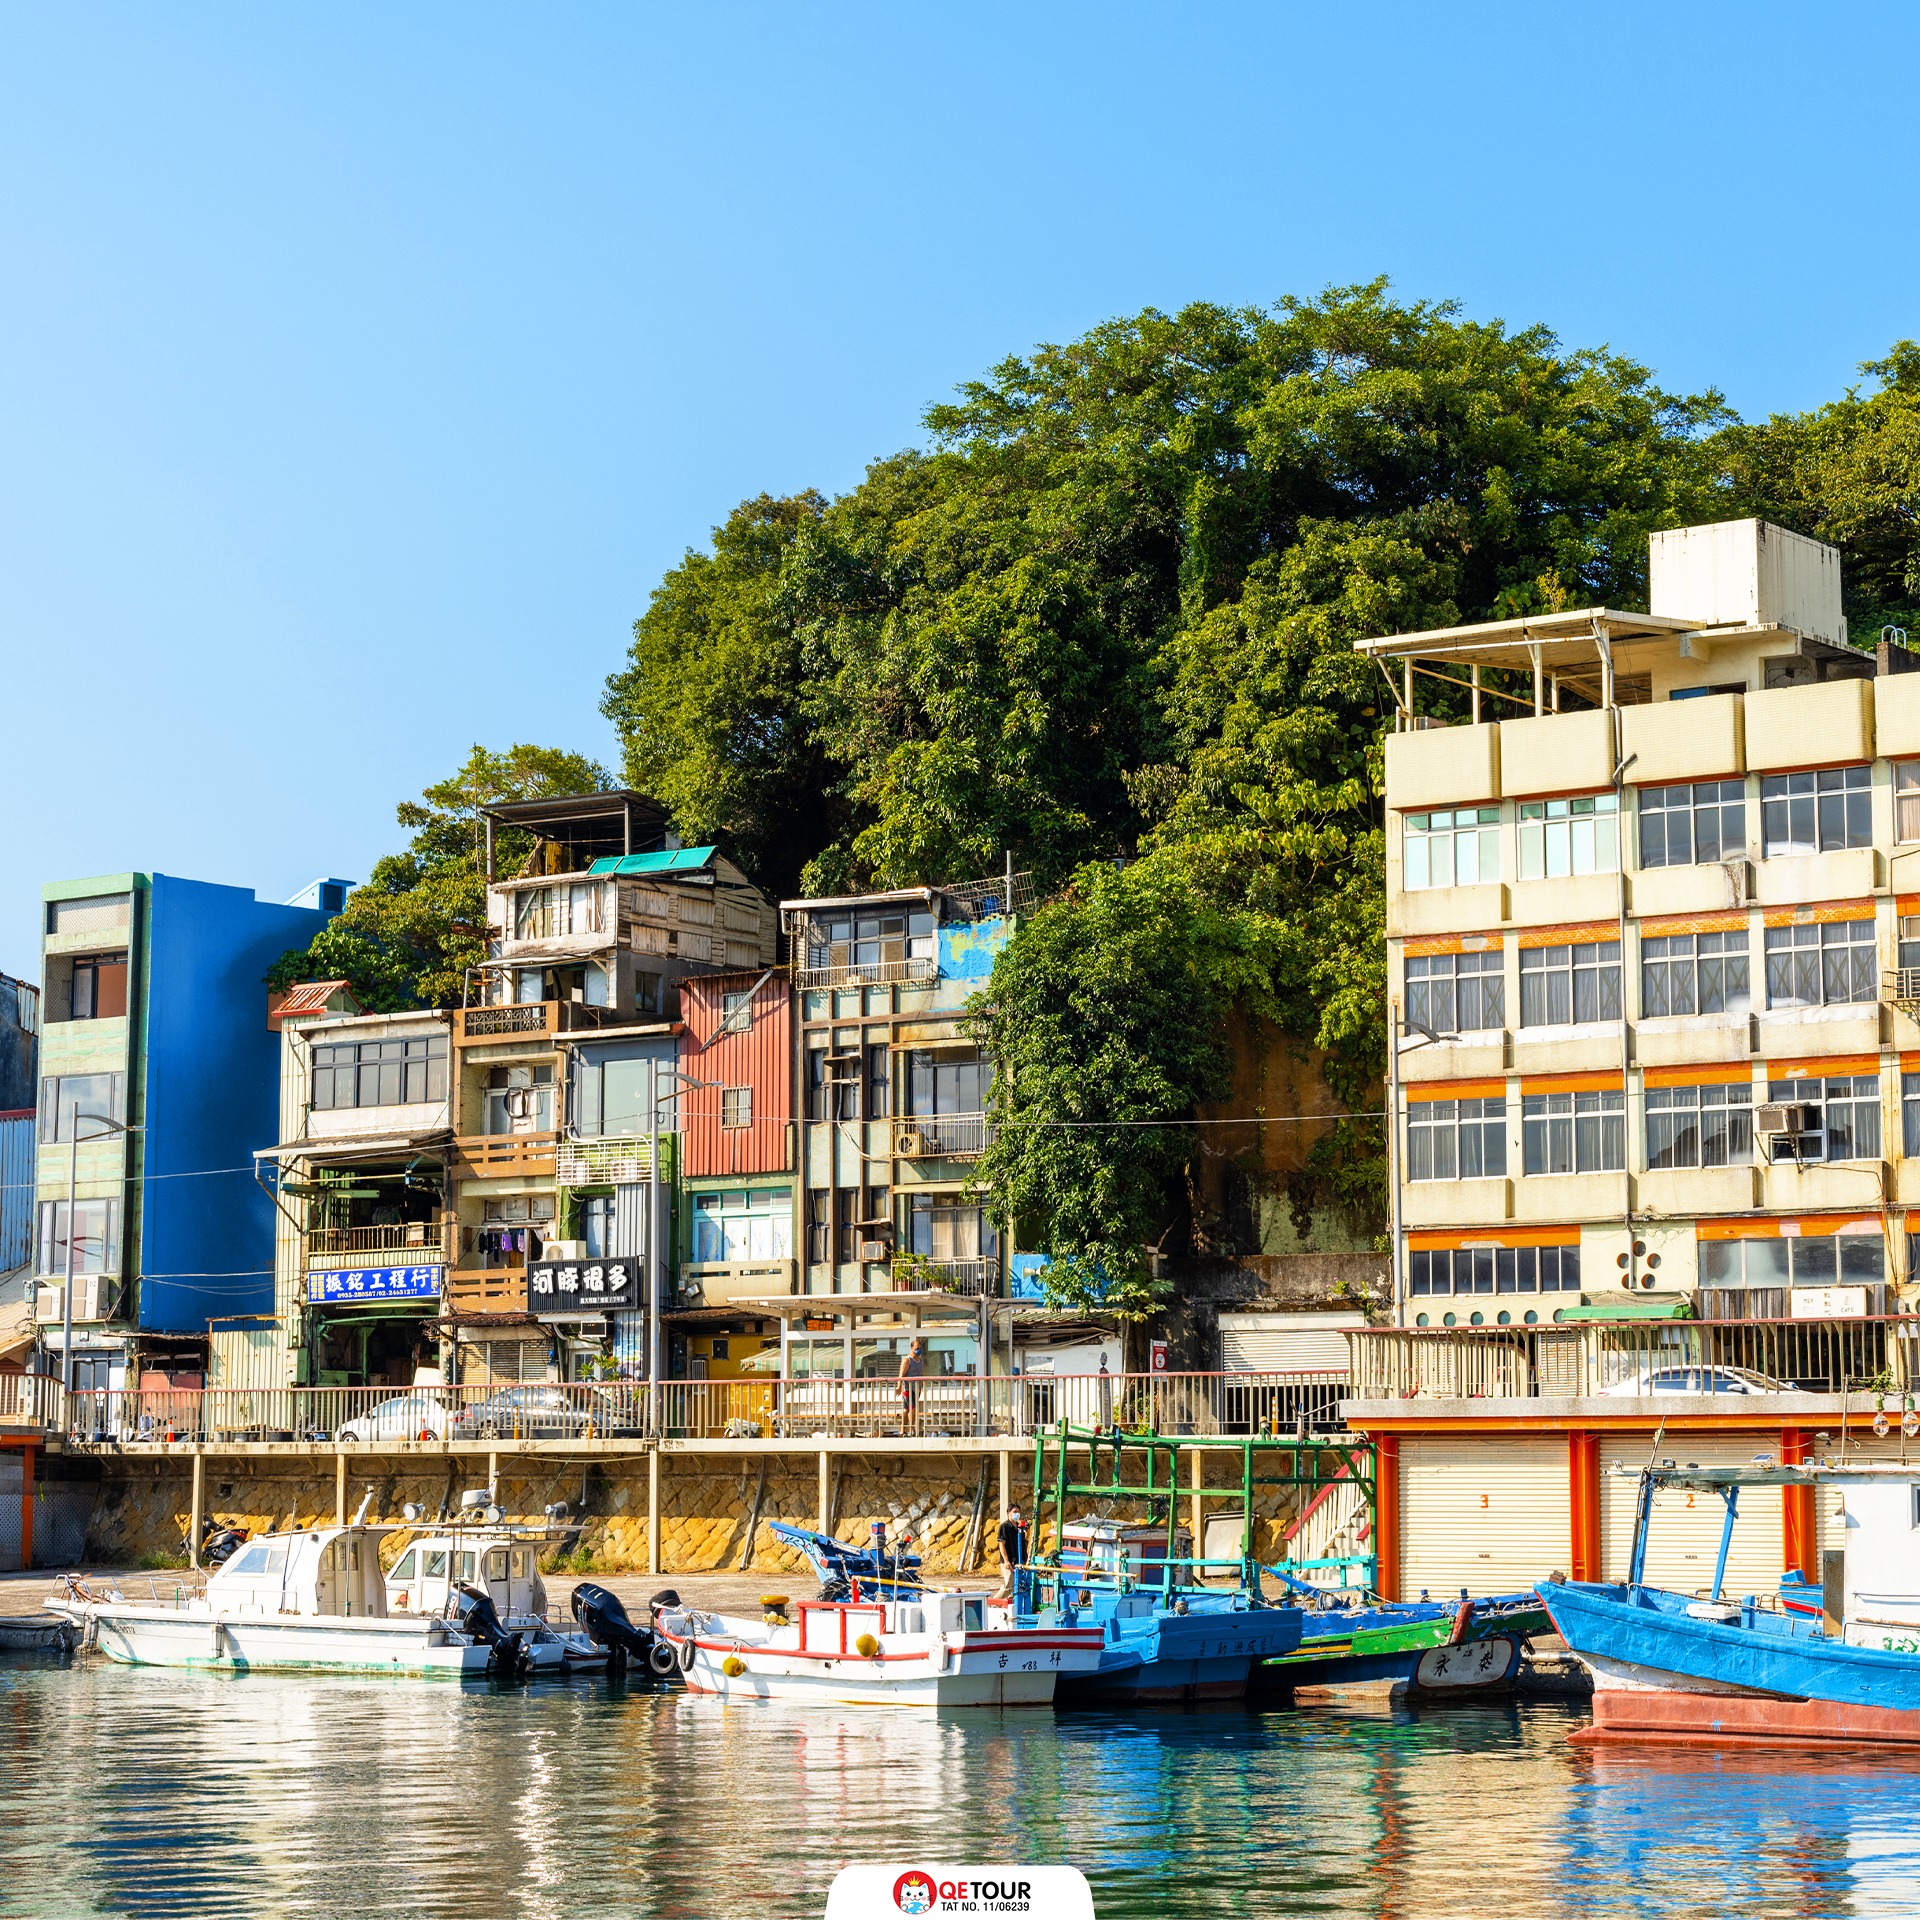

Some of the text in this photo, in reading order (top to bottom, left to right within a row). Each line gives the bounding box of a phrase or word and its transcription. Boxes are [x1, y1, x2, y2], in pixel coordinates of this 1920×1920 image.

[325, 1268, 430, 1293] 振銘工程行
[532, 1264, 628, 1294] 河豚很多
[1480, 1494, 1489, 1508] 3
[1686, 1493, 1696, 1508] 2
[998, 1653, 1009, 1669] 吉
[1049, 1650, 1062, 1667] 祥
